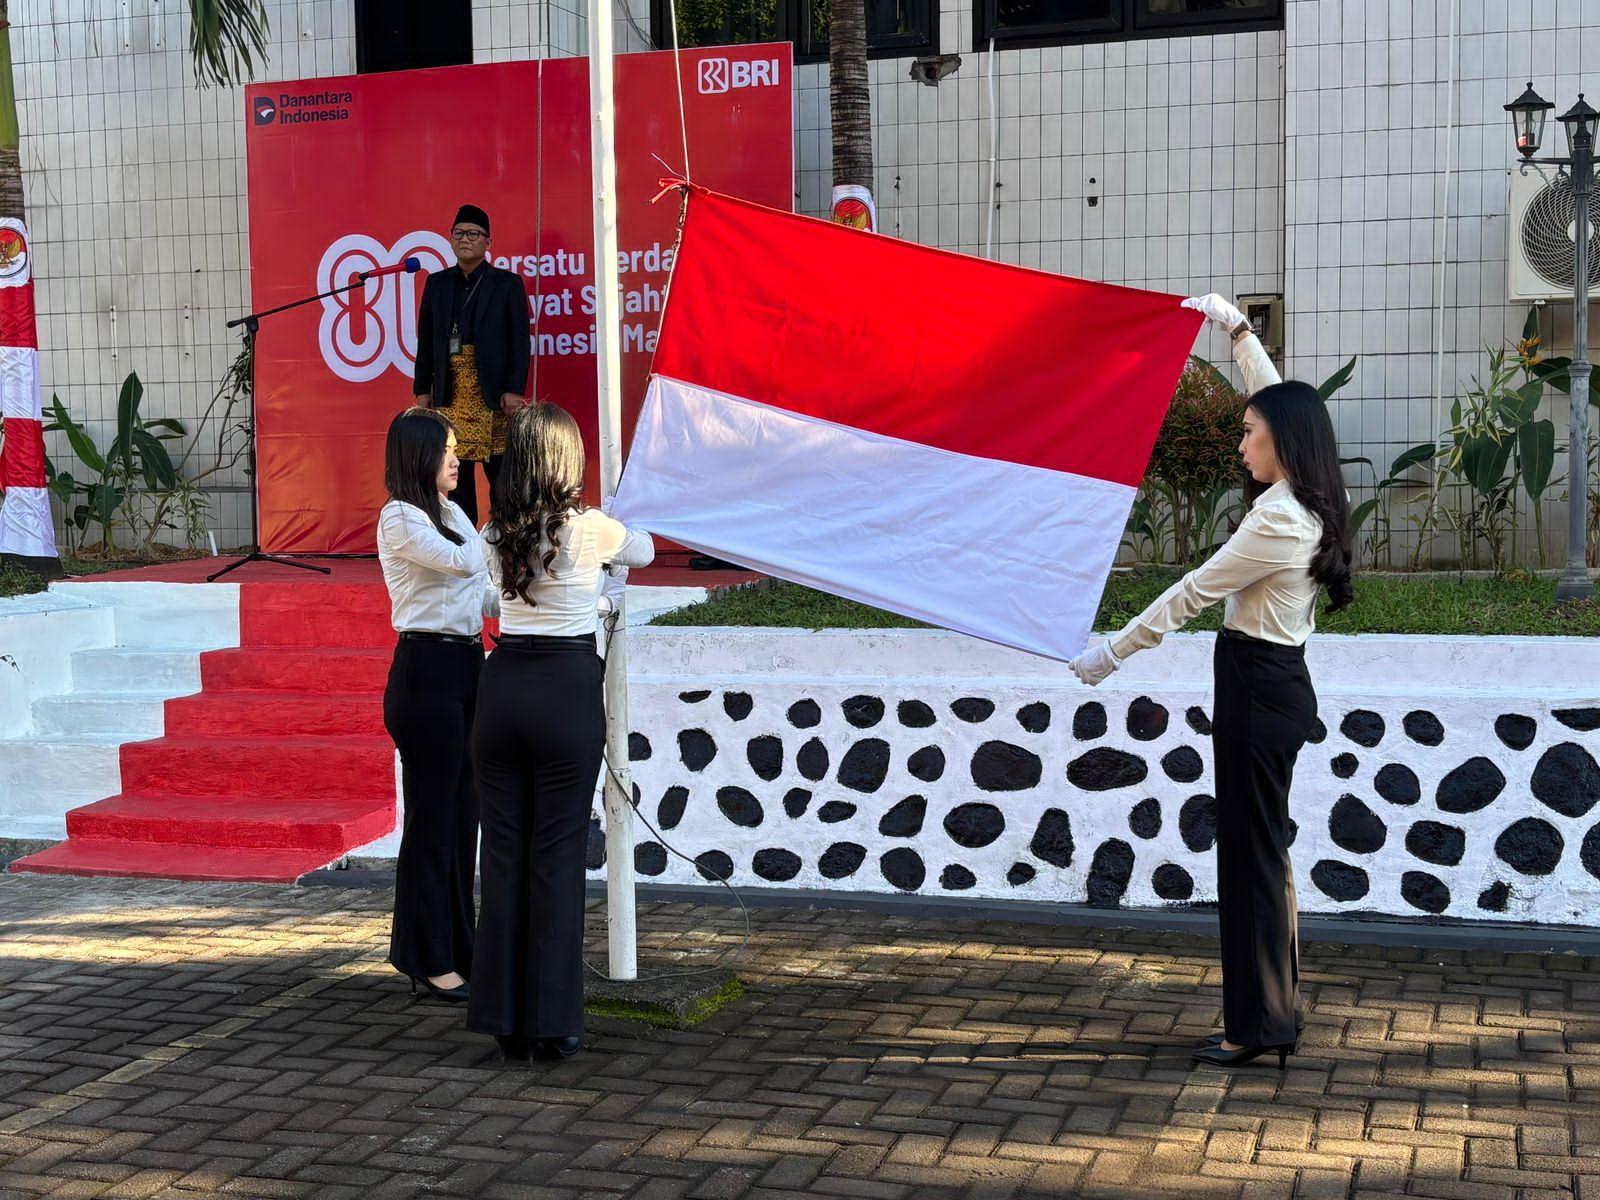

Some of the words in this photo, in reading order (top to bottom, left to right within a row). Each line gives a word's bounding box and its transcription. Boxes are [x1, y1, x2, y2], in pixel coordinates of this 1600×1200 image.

[731, 58, 779, 88] BRI
[280, 91, 353, 107] Danantara
[280, 107, 349, 124] Indonesia
[617, 242, 674, 273] erda
[528, 288, 573, 324] yat
[623, 323, 658, 352] Ma
